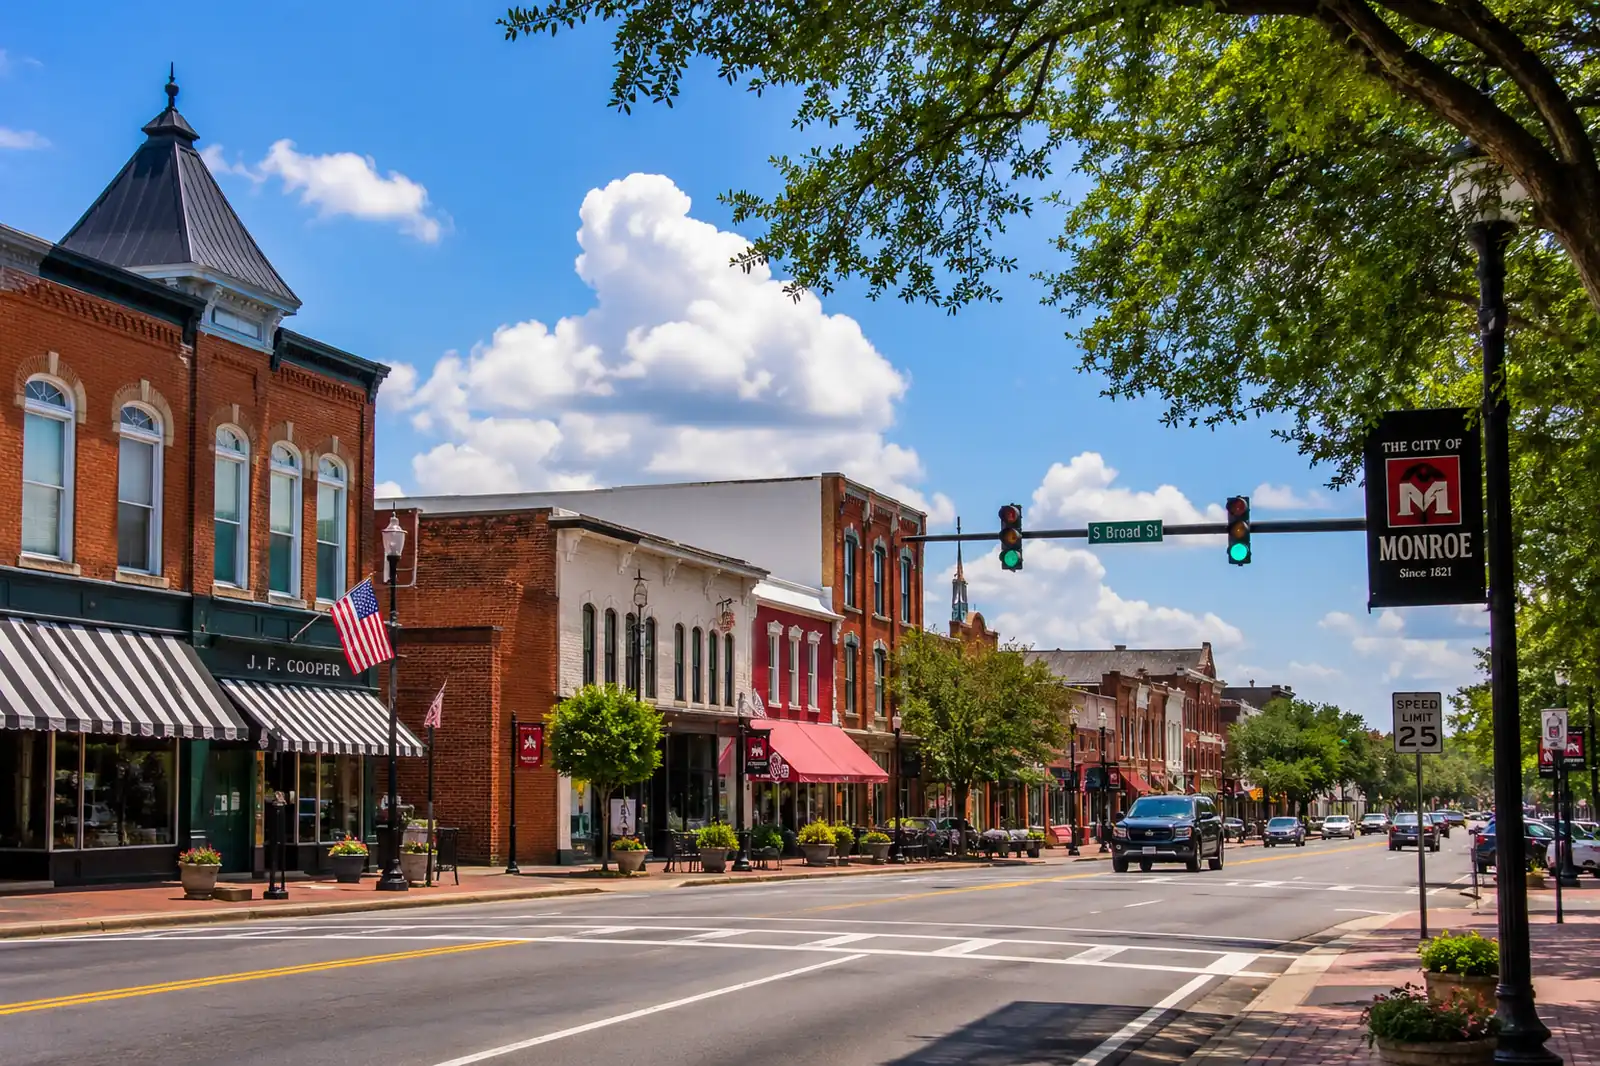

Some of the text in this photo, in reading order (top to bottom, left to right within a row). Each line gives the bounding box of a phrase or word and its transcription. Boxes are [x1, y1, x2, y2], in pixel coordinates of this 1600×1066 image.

[1382, 438, 1463, 453] THE CITY OF
[1397, 480, 1453, 516] M
[1093, 524, 1158, 539] S Broad St
[1379, 532, 1473, 561] MONROE
[1399, 567, 1452, 578] Since 1821
[247, 654, 340, 677] J. F. COOPER
[1397, 700, 1438, 709] SPEED
[1402, 713, 1433, 722] LIMIT
[1399, 726, 1438, 747] 25
